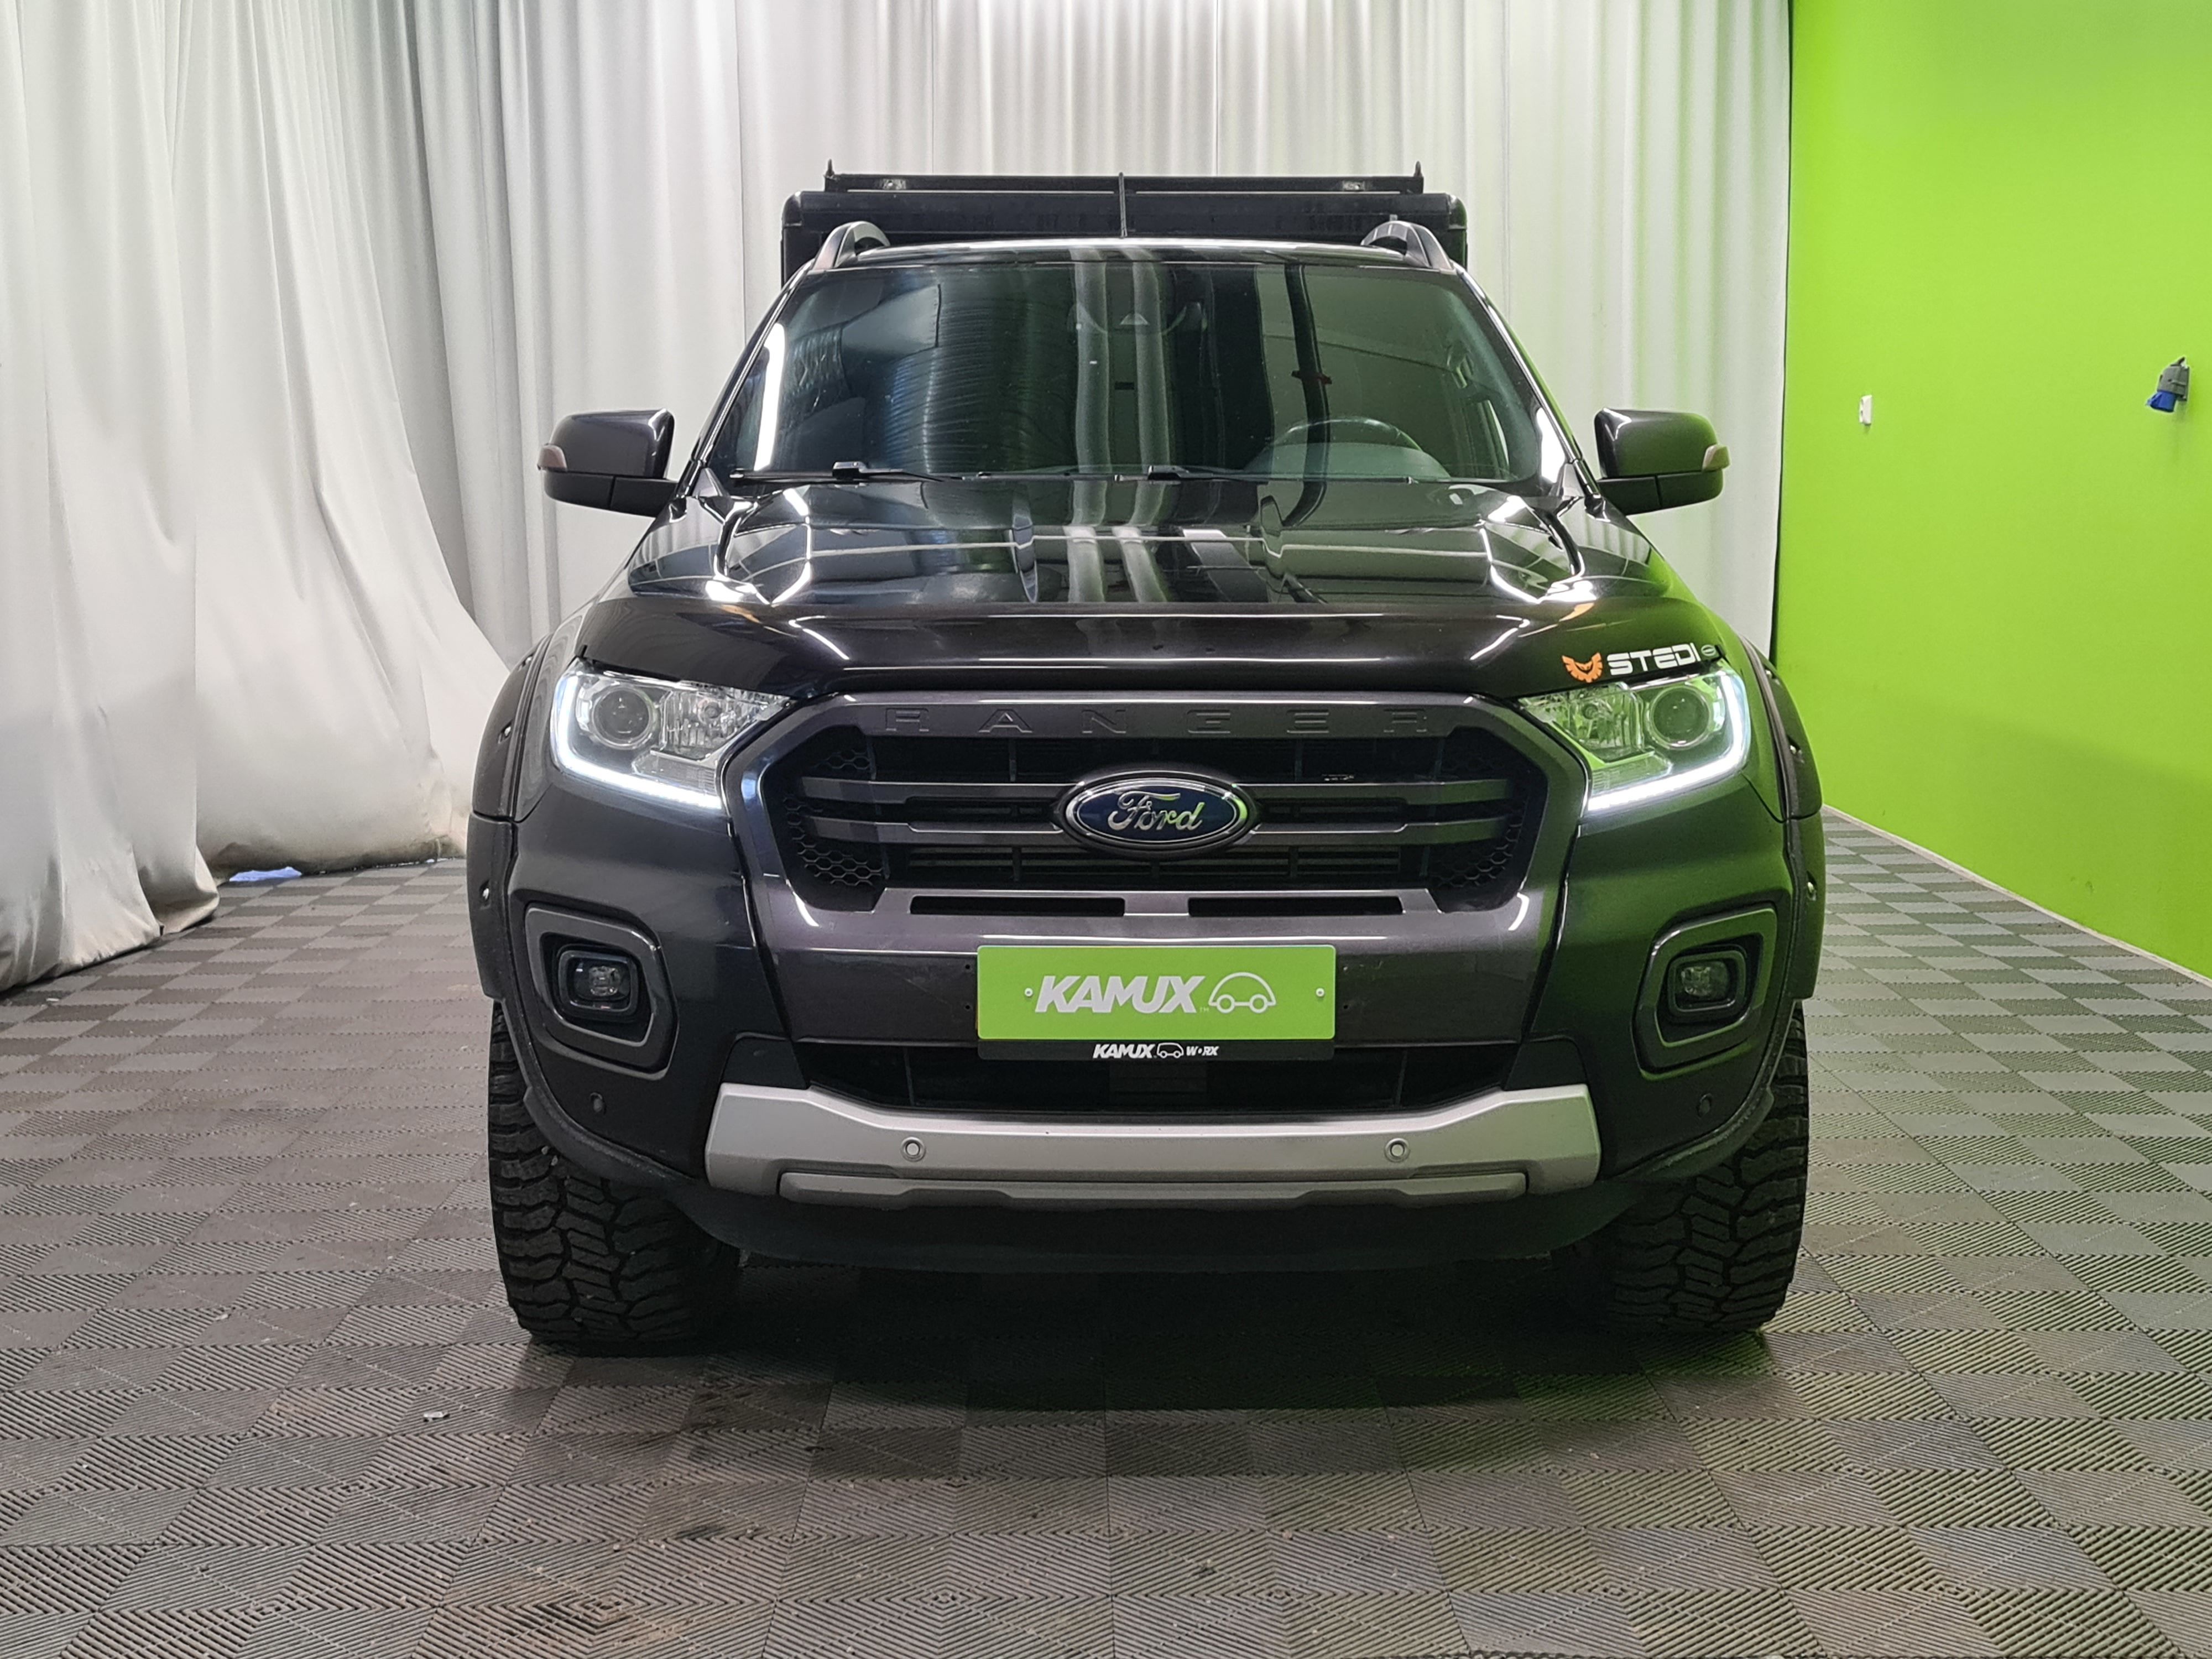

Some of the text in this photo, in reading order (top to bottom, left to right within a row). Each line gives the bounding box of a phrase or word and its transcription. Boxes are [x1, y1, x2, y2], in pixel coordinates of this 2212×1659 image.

[1607, 643, 1700, 675] STEDI
[886, 708, 1427, 733] RANGER
[1108, 791, 1206, 830] Ford
[1035, 975, 1206, 1013] KAMUX
[1093, 1044, 1155, 1058] KAMUX
